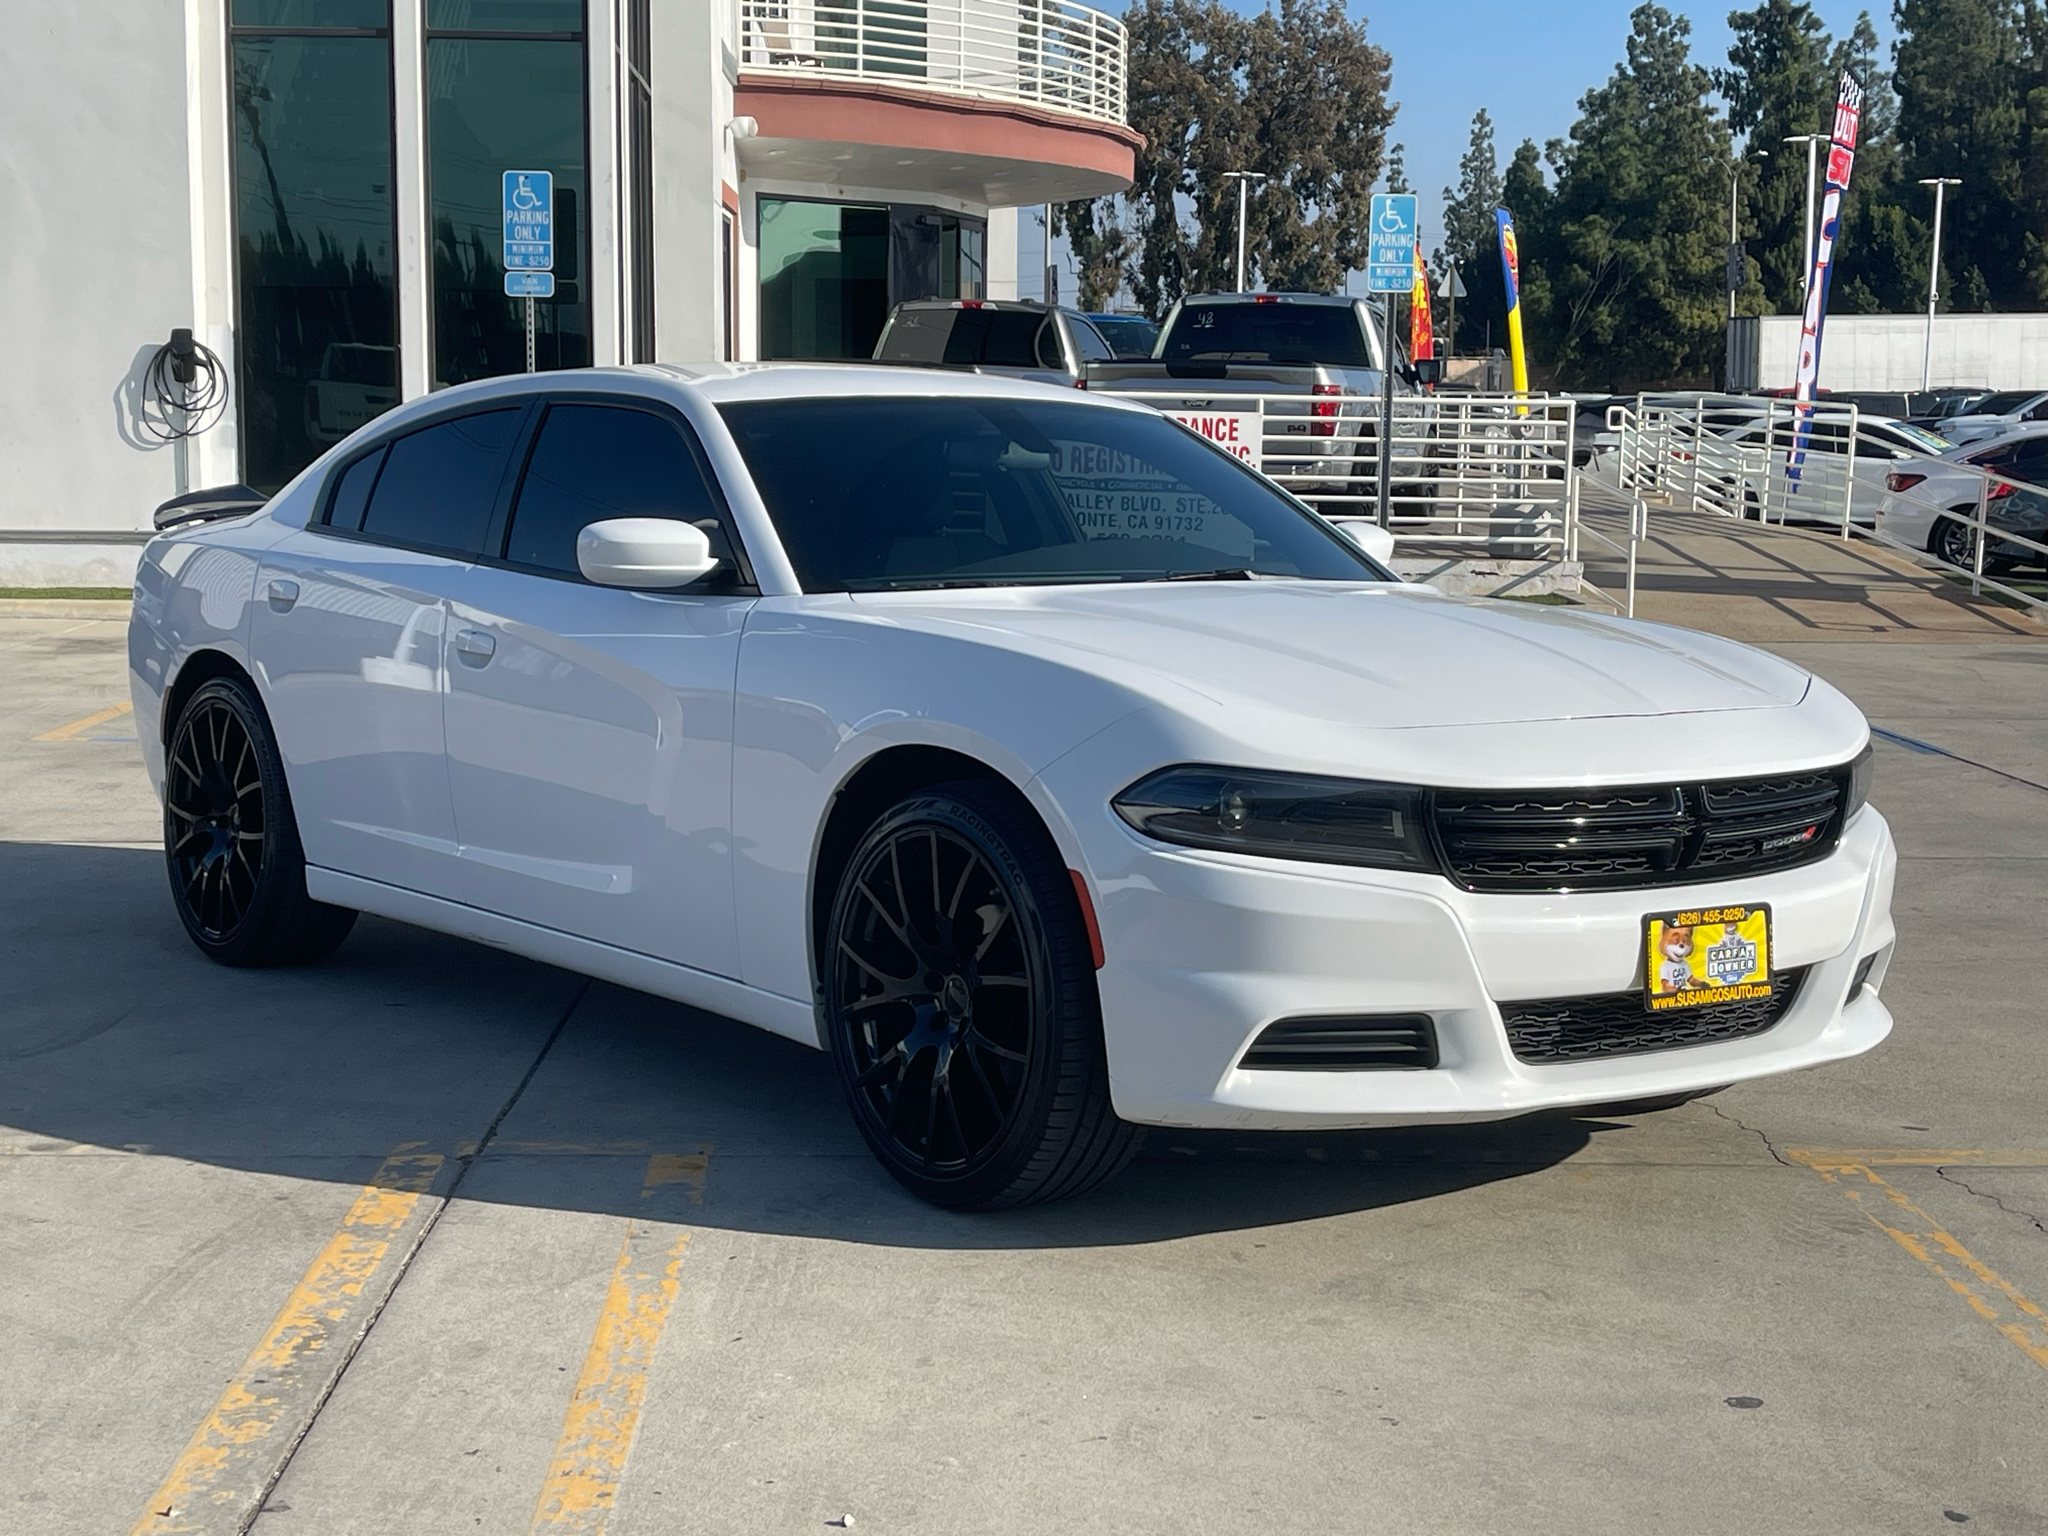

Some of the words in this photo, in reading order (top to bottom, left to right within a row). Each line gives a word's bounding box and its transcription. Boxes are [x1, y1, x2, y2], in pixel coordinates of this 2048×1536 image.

[507, 210, 549, 225] PARKING
[514, 226, 541, 240] ONLY
[1372, 233, 1413, 248] PARKING
[512, 244, 544, 254] MINIMUM
[1380, 249, 1405, 263] ONLY
[507, 255, 523, 265] FINE
[528, 256, 549, 266] $250
[1376, 267, 1407, 277] MINIMUM
[1371, 278, 1387, 288] FINE
[1391, 278, 1411, 289] $250
[1198, 311, 1214, 325] 48
[1108, 480, 1164, 491] COMMERCIAL
[1067, 493, 1114, 510] ALLEY
[1121, 496, 1166, 512] BLVD.
[1076, 511, 1121, 530] ONTE,
[1127, 514, 1149, 529] CA
[1154, 516, 1204, 532] 91732
[1677, 911, 1701, 925] (626)
[1703, 907, 1745, 923] 455-0250
[1710, 947, 1753, 961] CARFAX
[1718, 960, 1754, 973] OWNER
